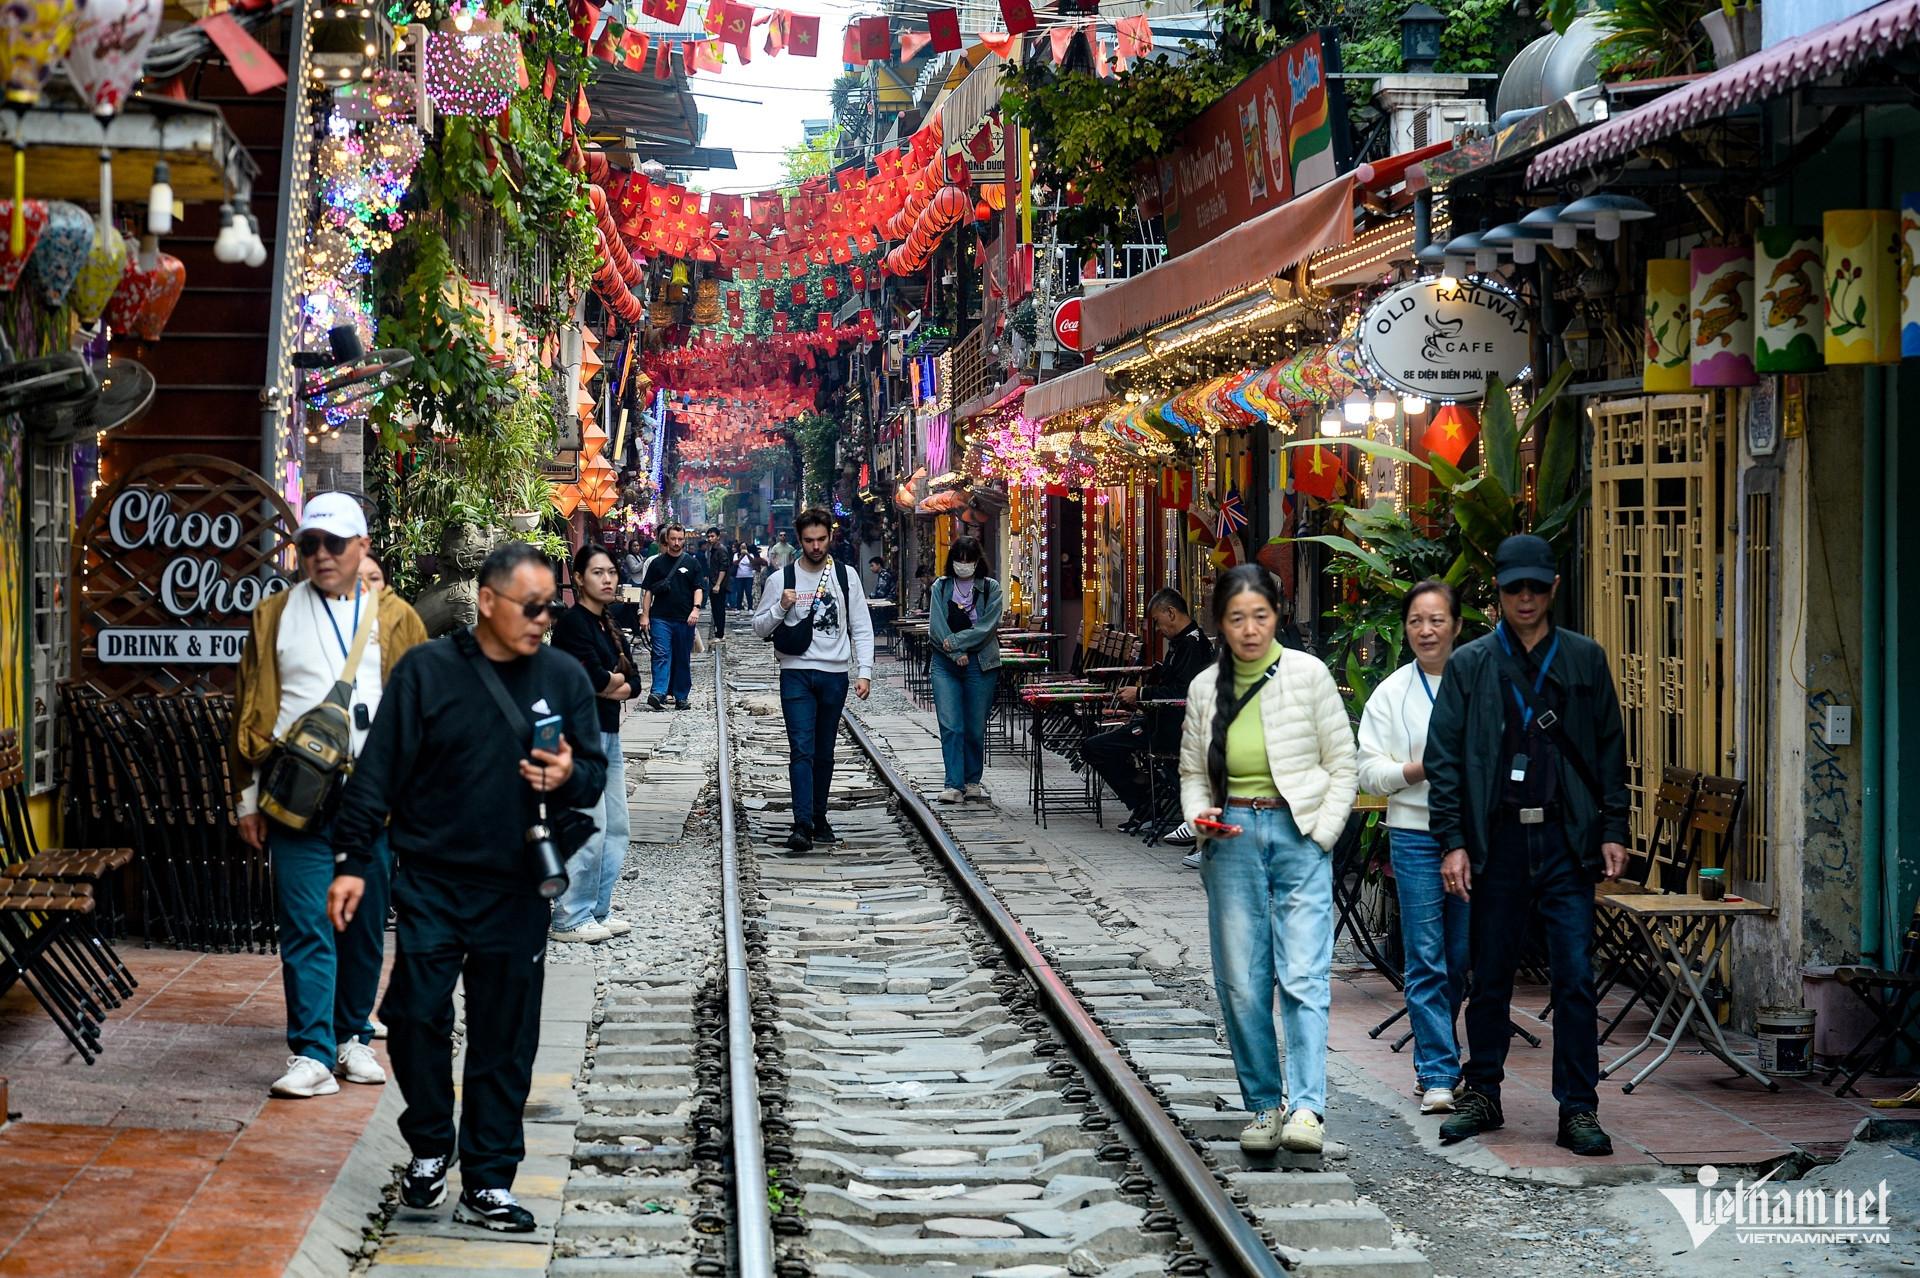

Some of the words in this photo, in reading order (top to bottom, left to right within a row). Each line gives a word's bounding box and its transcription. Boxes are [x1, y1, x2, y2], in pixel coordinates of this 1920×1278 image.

[965, 159, 984, 171] ÔNG
[1377, 297, 1416, 334] OLD
[1436, 288, 1528, 335] RAILWAY
[1446, 342, 1494, 353] CAFE
[1403, 370, 1415, 379] 8E
[1418, 368, 1439, 382] ĐIỆN
[1441, 368, 1462, 380] BIÊN
[108, 488, 242, 551] Choo
[107, 635, 178, 657] DRINK
[187, 635, 202, 656] &
[210, 635, 248, 657] FOO
